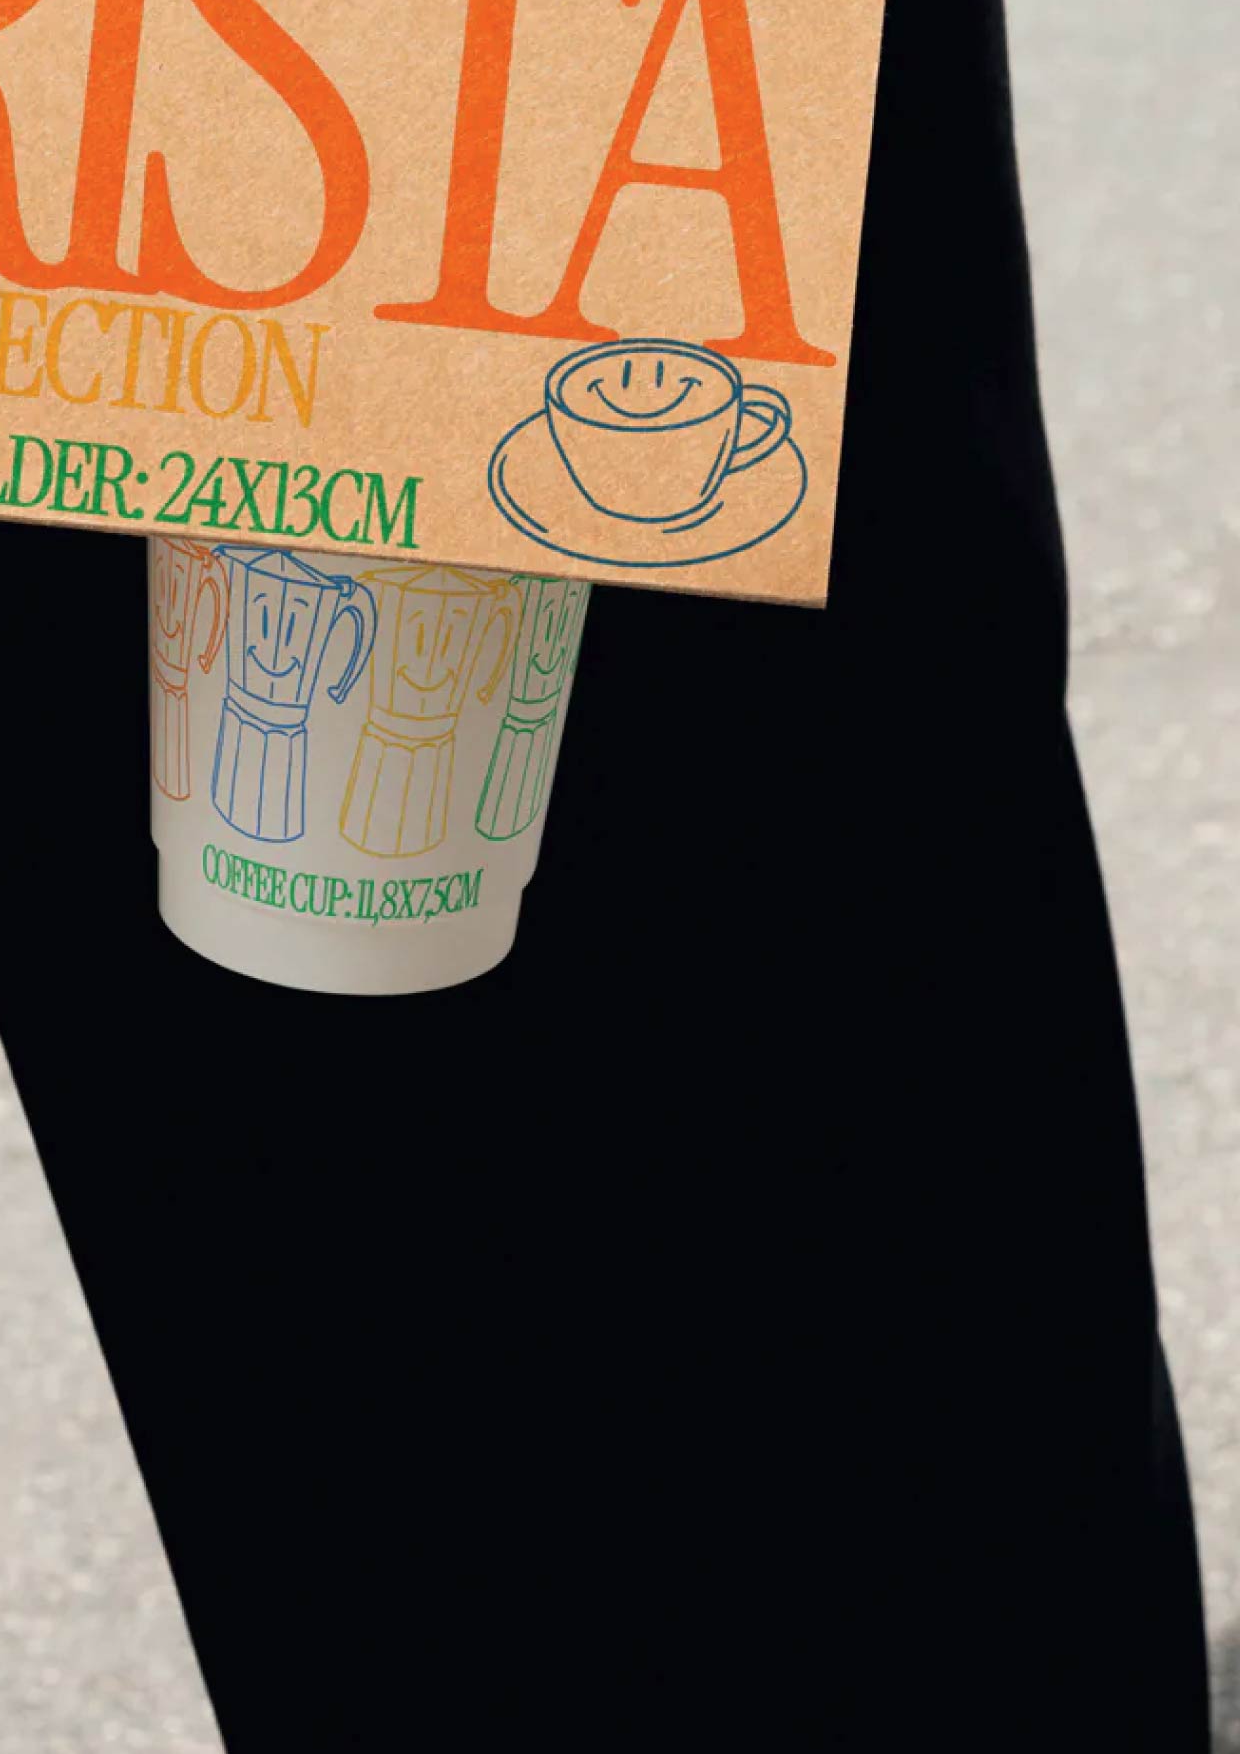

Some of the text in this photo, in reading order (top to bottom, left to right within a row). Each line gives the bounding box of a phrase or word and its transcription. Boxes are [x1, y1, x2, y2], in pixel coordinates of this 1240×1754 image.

[154, 449, 424, 550] 24X13CM
[201, 843, 485, 927] COFFEE CUP: 11,8X7,5CM
